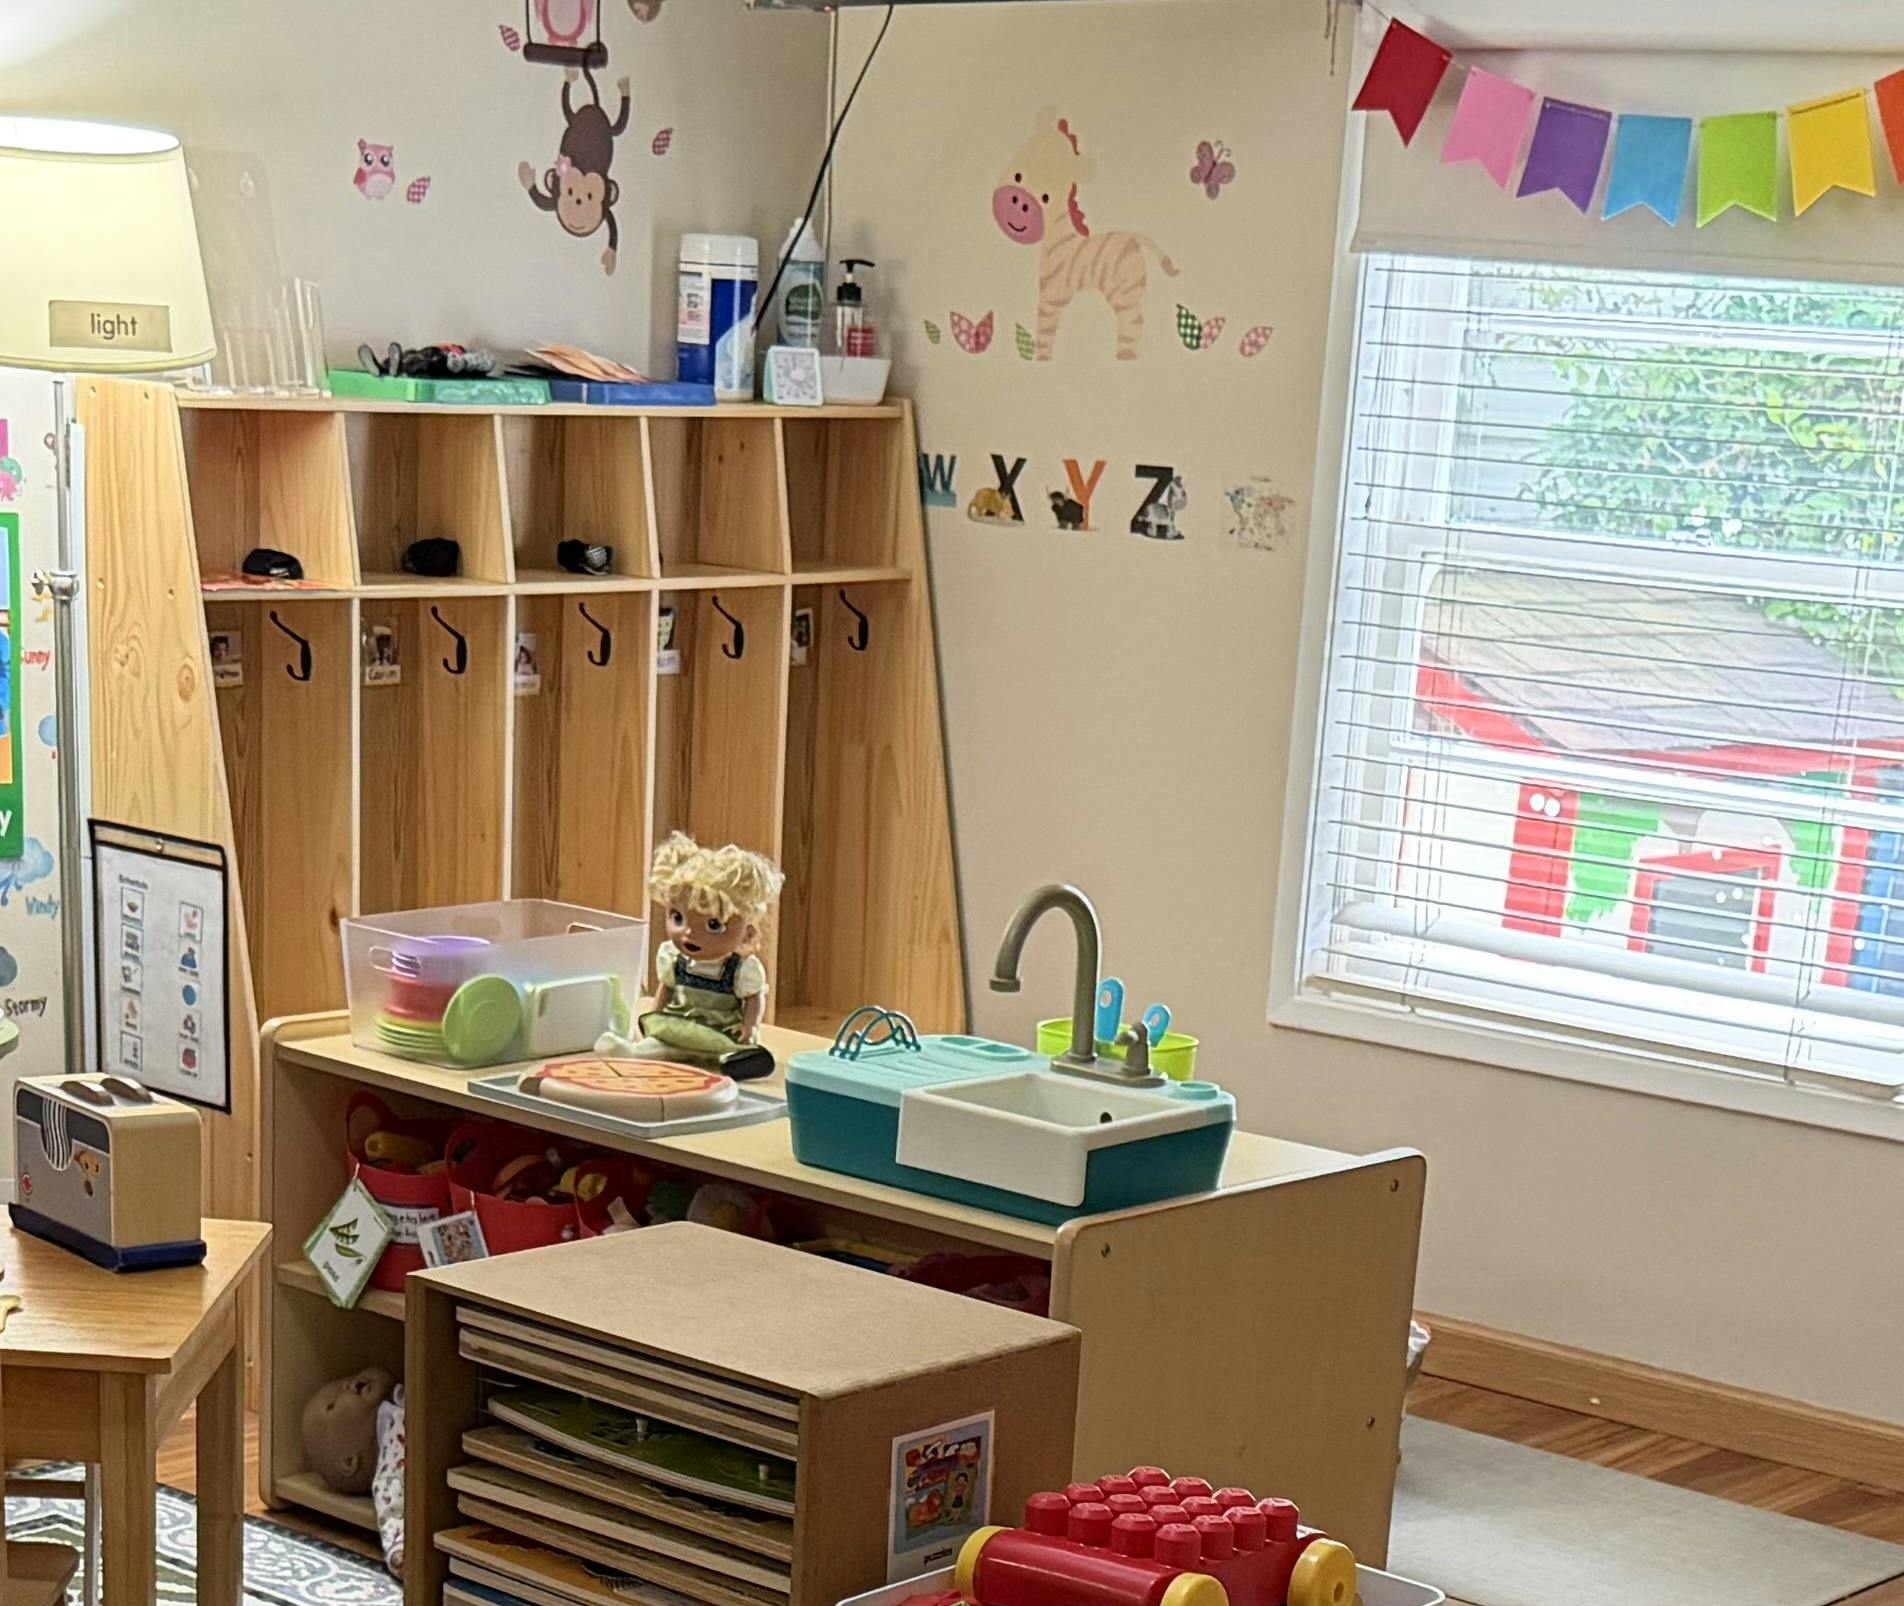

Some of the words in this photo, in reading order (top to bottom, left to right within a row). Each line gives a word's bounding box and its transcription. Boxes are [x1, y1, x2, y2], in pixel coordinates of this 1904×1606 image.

[90, 313, 138, 340] light
[990, 453, 1028, 521] X
[1062, 459, 1106, 531] Y
[1130, 464, 1186, 540] Z
[5, 997, 48, 1018] Stormy
